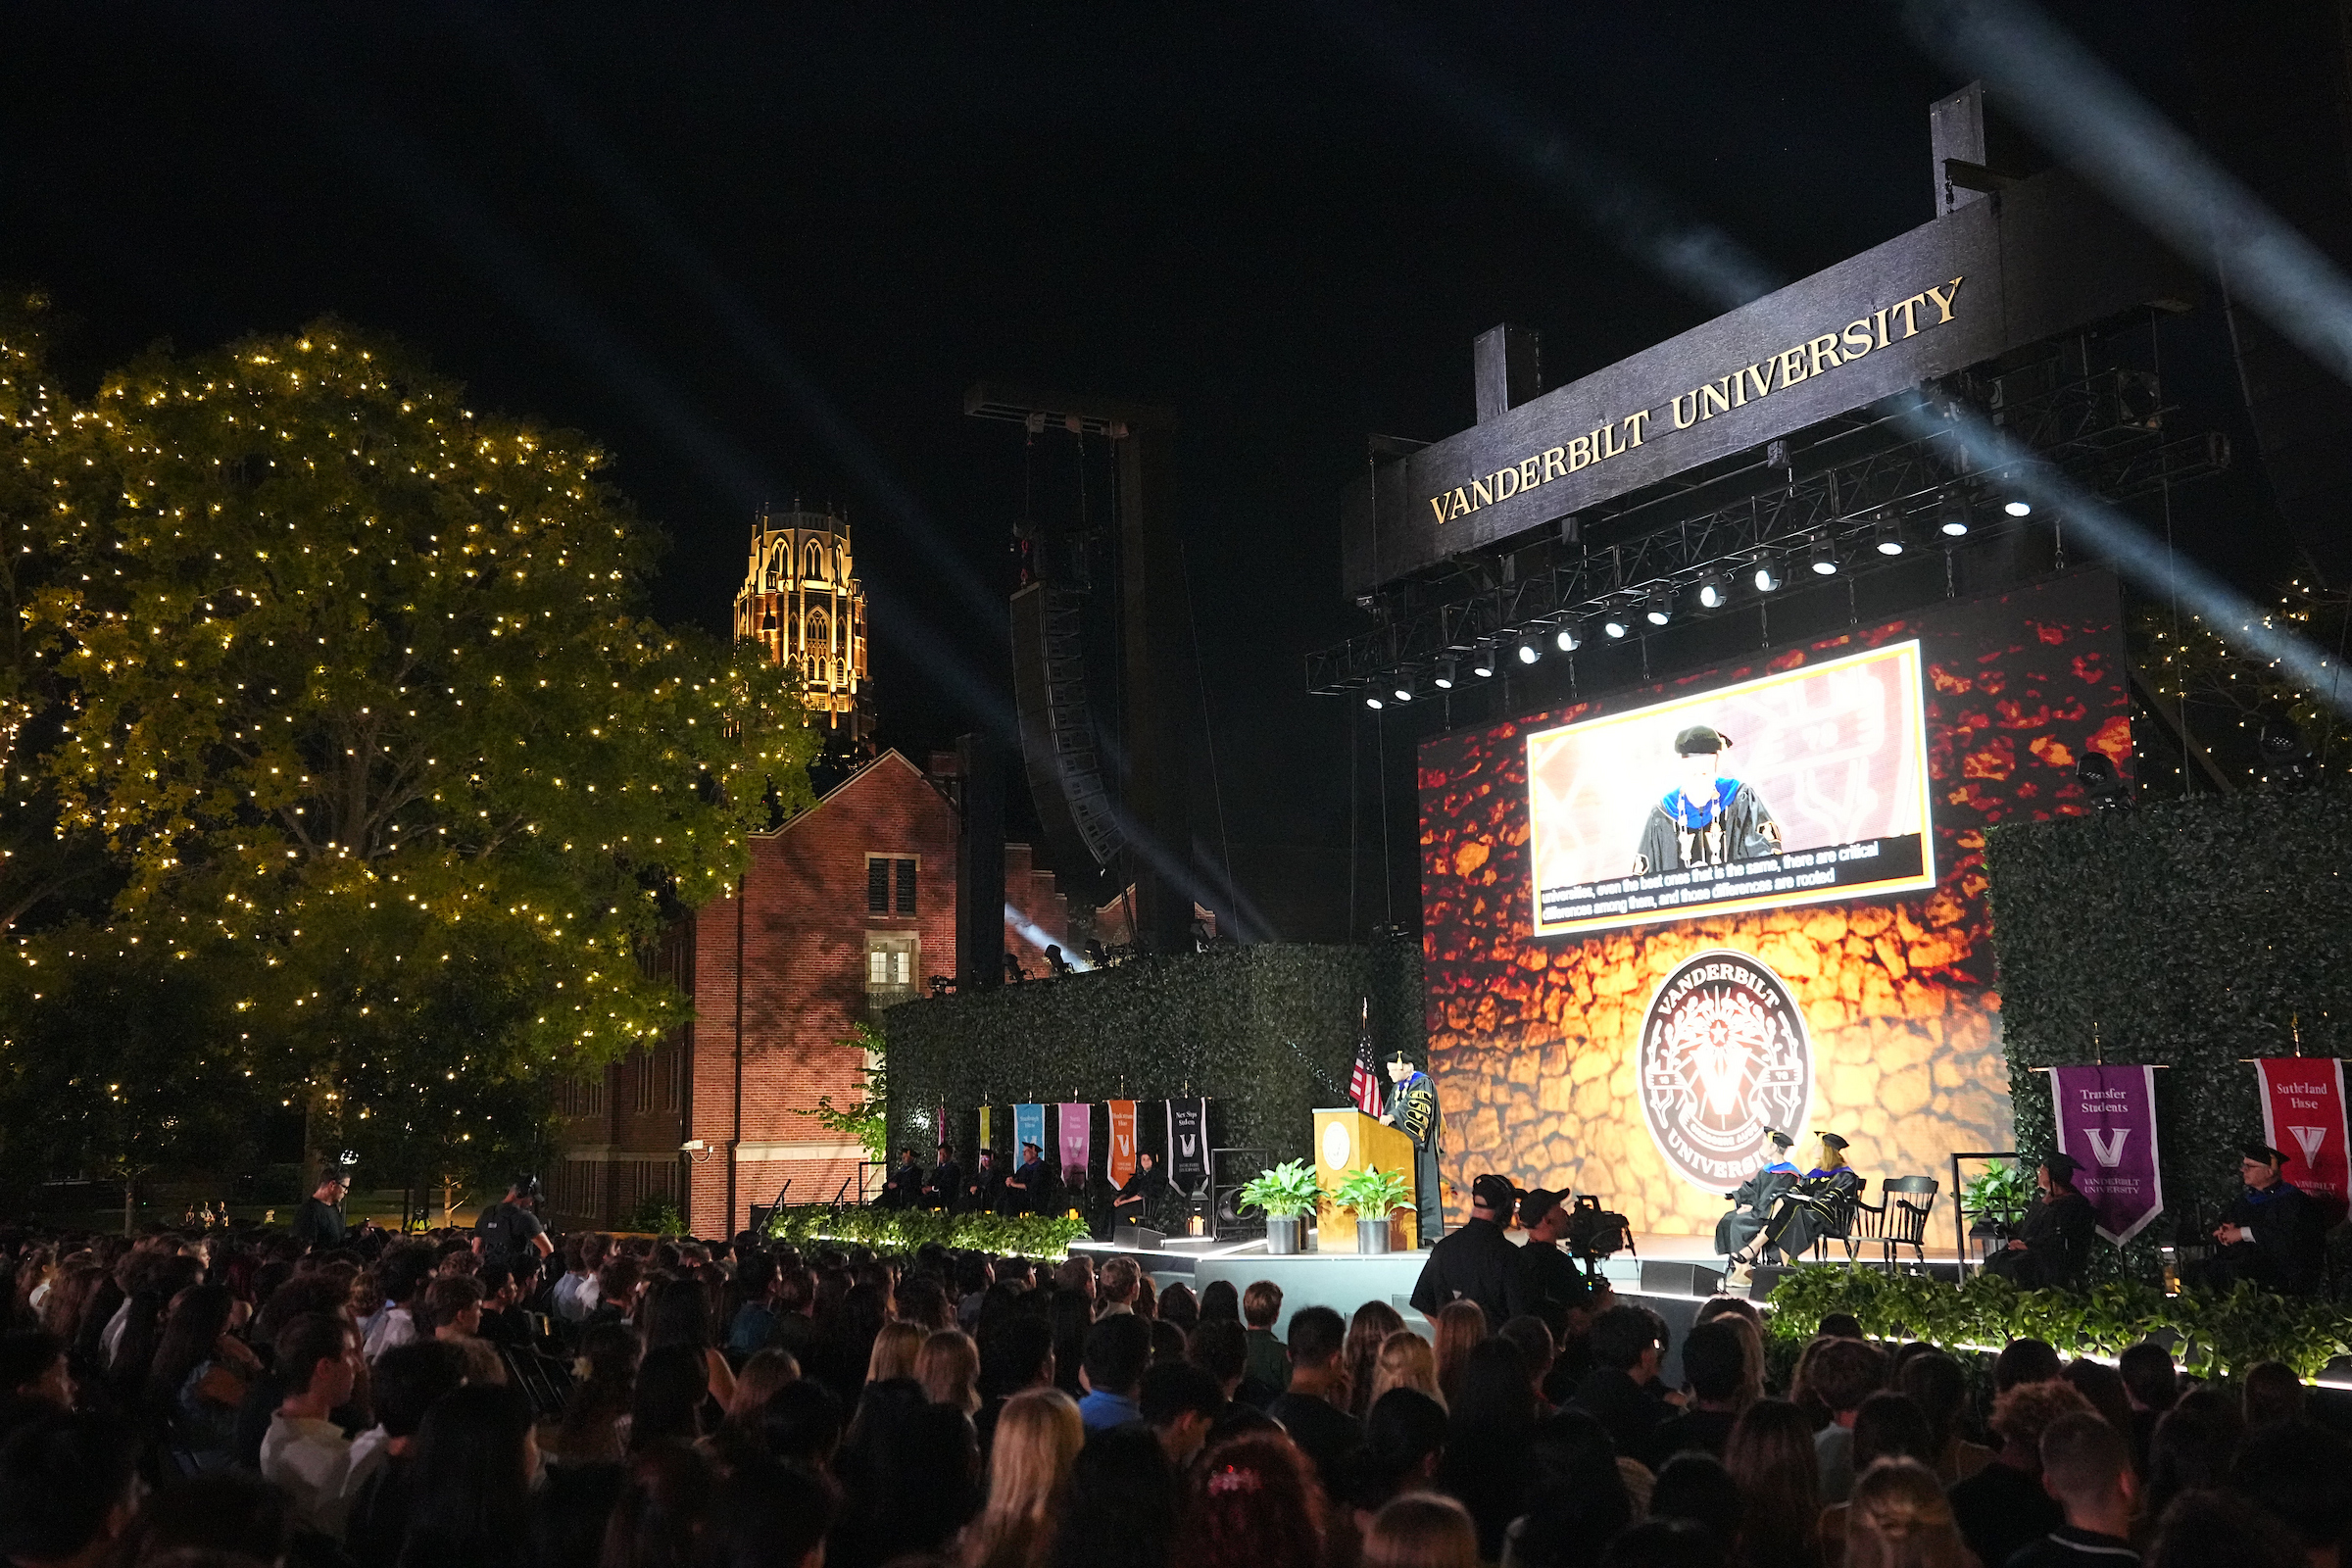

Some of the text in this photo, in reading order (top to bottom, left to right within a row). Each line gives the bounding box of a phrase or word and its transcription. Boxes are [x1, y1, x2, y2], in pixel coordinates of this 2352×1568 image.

[1430, 276, 1964, 525] VANDERBILT UNIVERSITY
[1542, 842, 1879, 904] universities, even the best ones that is the same, there are critical
[1543, 867, 1836, 920] differences among them, and those differences are rooted
[1658, 963, 1781, 1016] VANDERBILT
[2080, 1088, 2127, 1100] Transfer
[2081, 1102, 2129, 1113] Students
[2277, 1082, 2328, 1095] Suteland
[1668, 1128, 1767, 1178] UNIVERSI
[2082, 1127, 2132, 1167] V
[2084, 1186, 2140, 1195] UNIVERSITY
